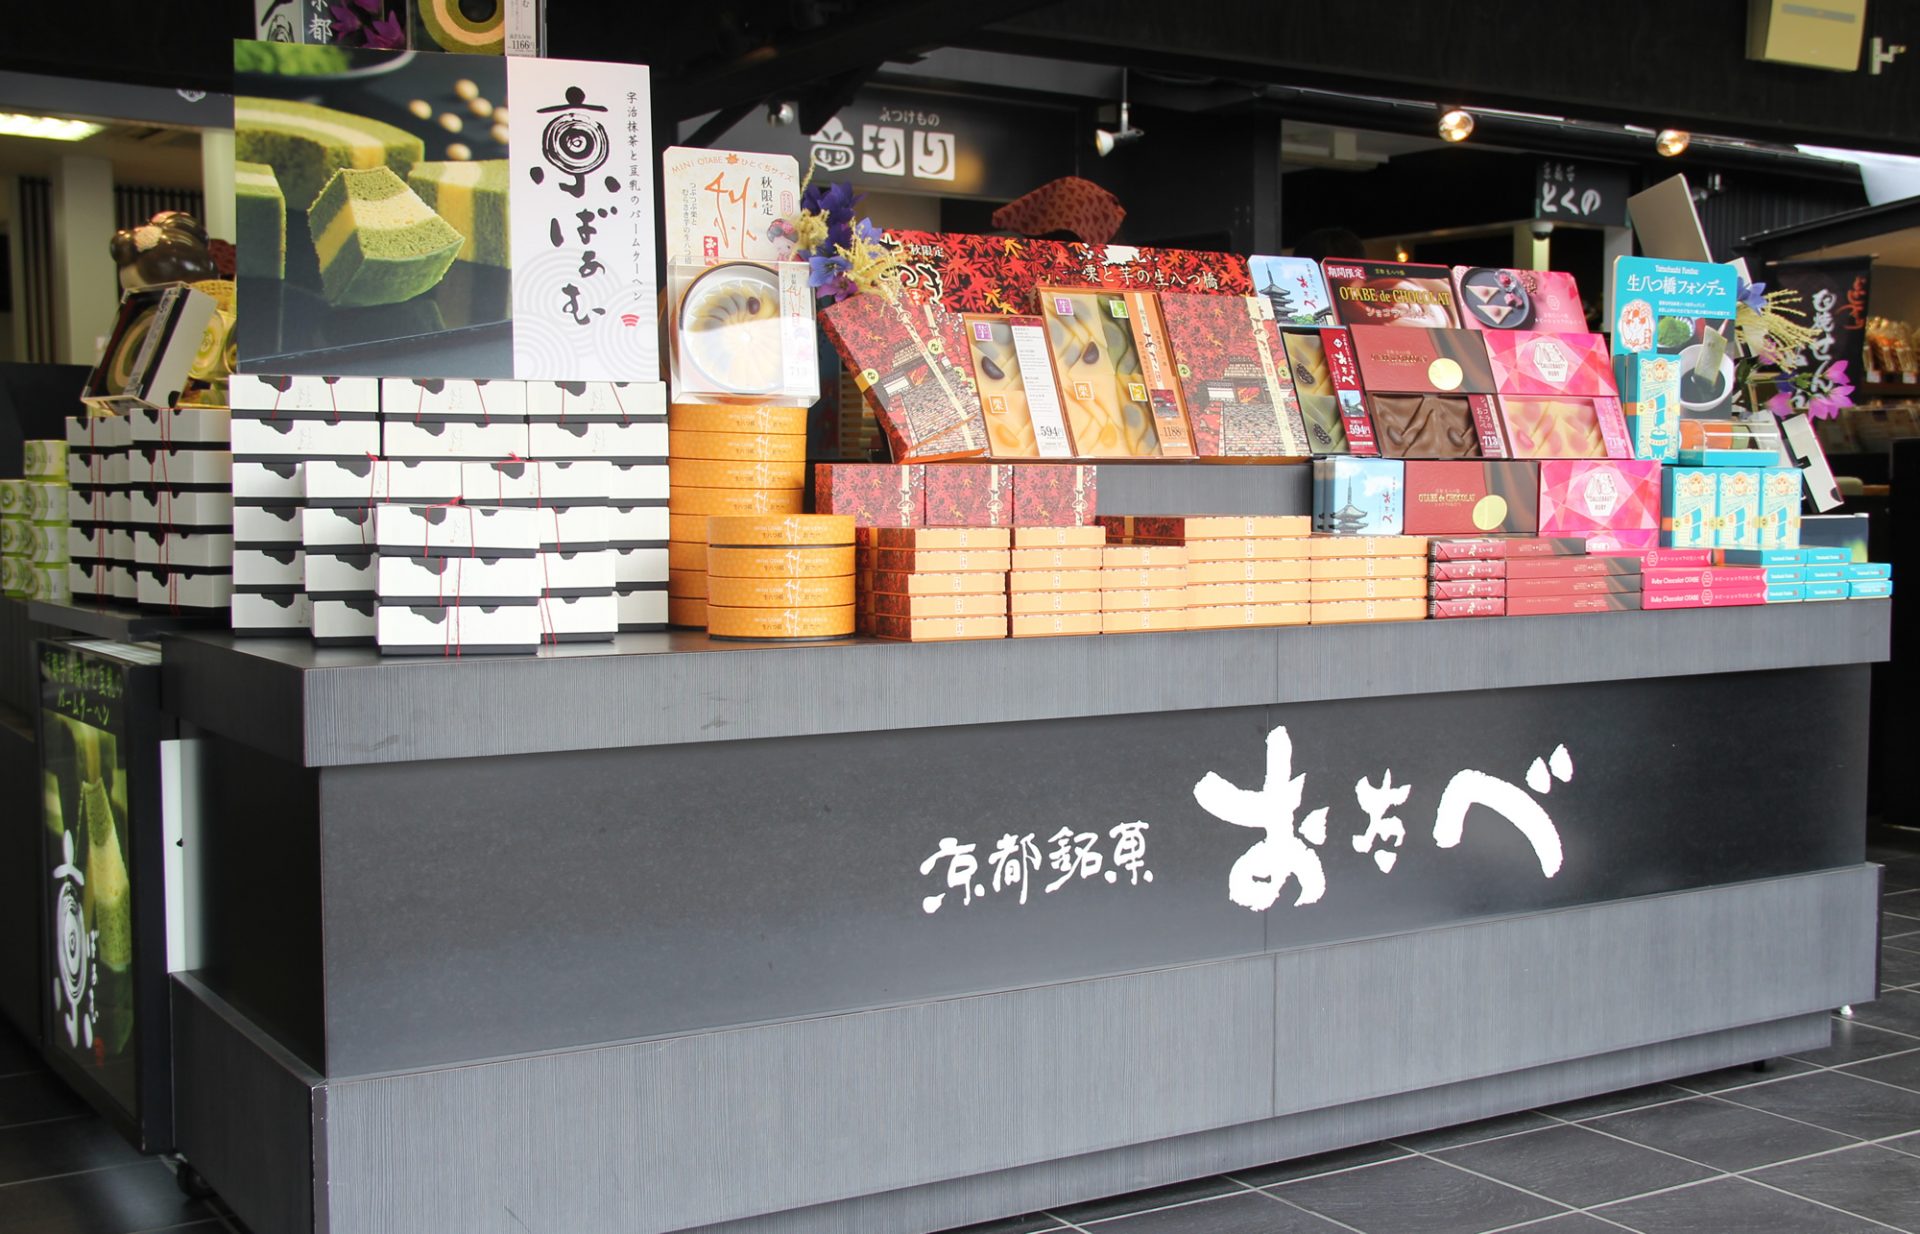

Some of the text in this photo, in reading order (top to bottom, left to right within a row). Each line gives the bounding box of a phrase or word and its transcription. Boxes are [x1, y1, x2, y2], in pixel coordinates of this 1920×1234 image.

[671, 161, 695, 174] MINI
[741, 159, 794, 182] ひとくちサイズ
[626, 91, 644, 302] 宇治抹茶と豆乳のバームクーヘン
[761, 175, 774, 216] 秋限定
[1541, 181, 1602, 216] とくの
[909, 243, 945, 257] 秋限定
[1085, 263, 1219, 291] 栗と芋の生八つ橋
[1328, 267, 1365, 279] 期間限定
[1626, 273, 1727, 296] 生八つ橋フォンデュ
[1339, 286, 1450, 306] OTABE de CHOCOLAT
[1193, 725, 1574, 913] おたべ
[920, 820, 1154, 914] 京都銘菓
